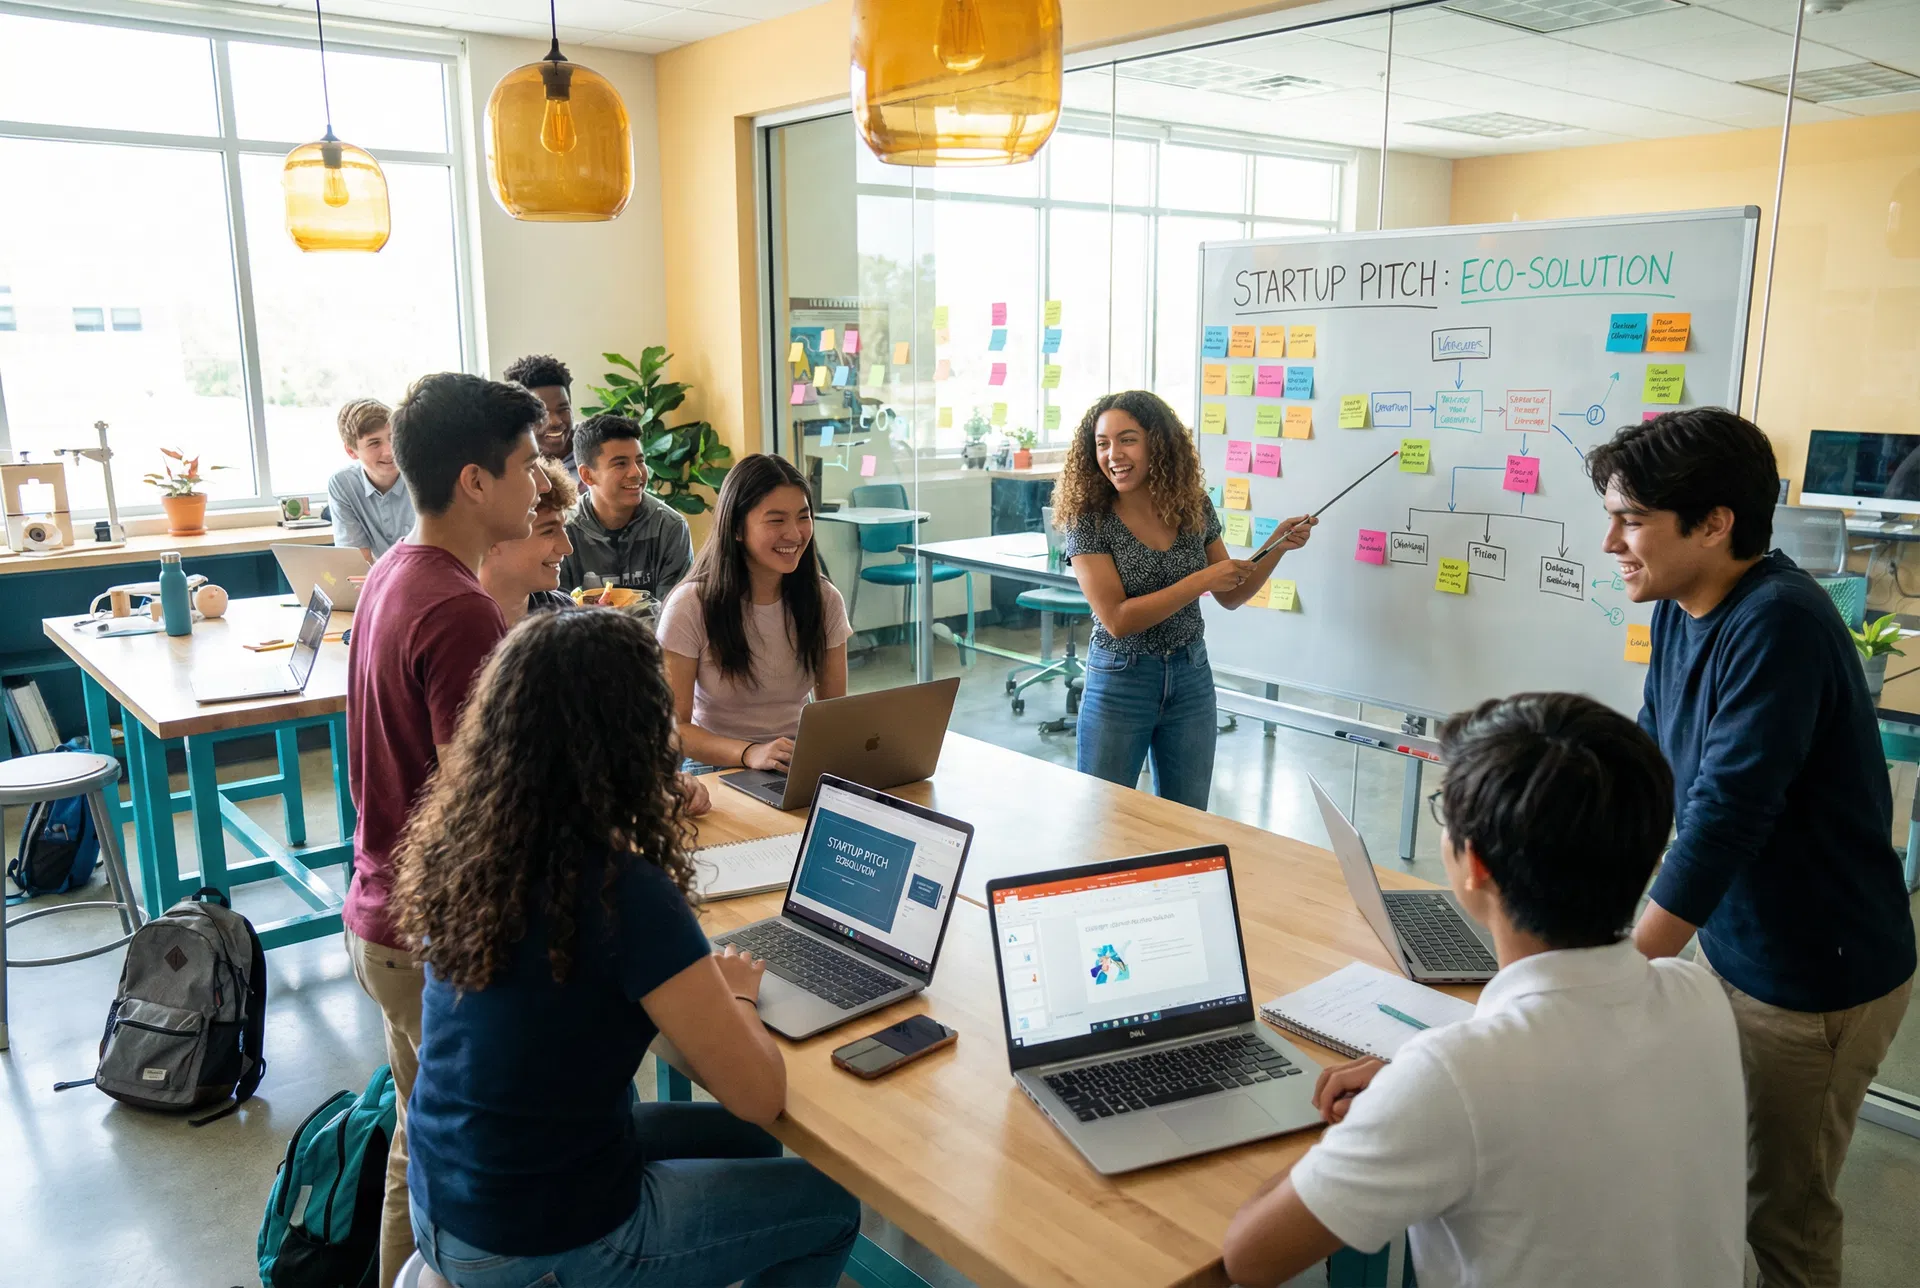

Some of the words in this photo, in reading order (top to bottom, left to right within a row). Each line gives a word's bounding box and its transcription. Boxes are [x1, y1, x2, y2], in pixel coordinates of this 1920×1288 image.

[1234, 265, 1346, 307] STARTUP
[1460, 251, 1674, 294] ECO-SOLUTION
[827, 836, 864, 859] STARTUP
[863, 850, 889, 870] PITCH
